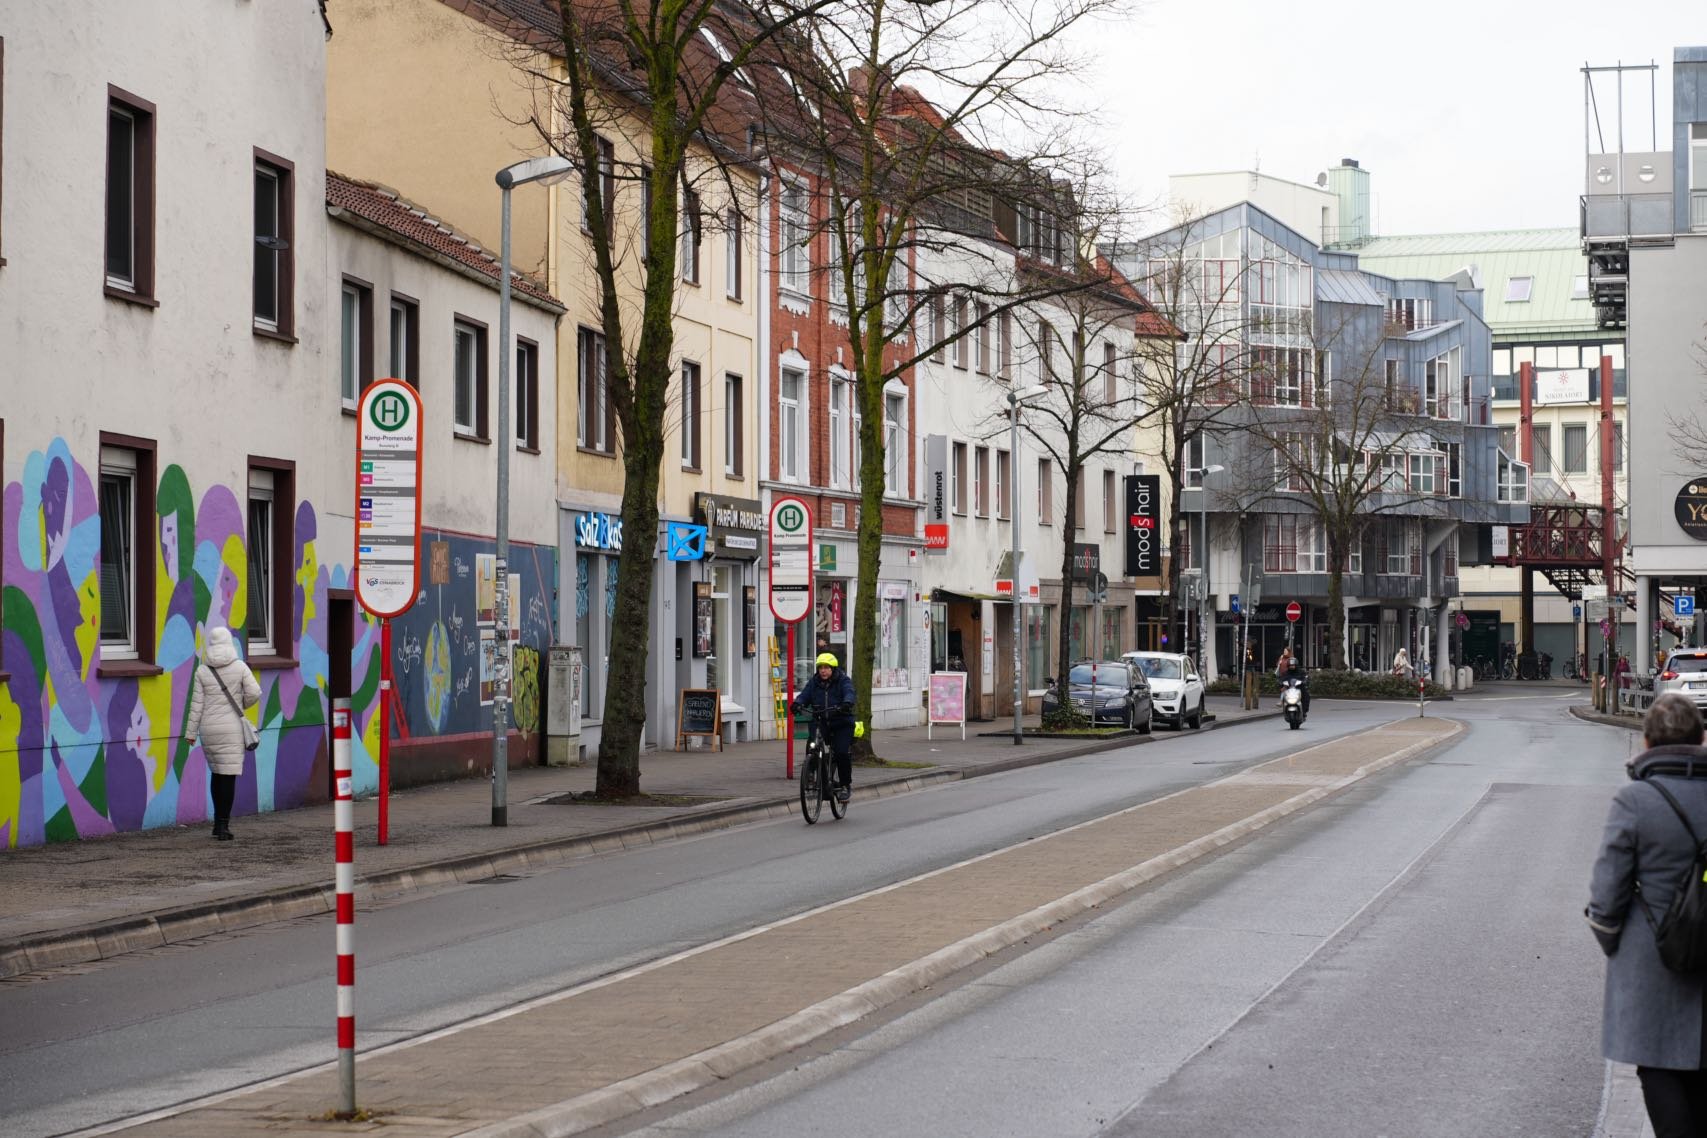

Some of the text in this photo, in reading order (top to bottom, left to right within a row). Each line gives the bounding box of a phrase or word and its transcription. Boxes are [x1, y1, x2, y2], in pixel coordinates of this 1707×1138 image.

[382, 400, 397, 422] H
[934, 471, 943, 520] wüstenrot
[784, 510, 796, 526] H
[832, 582, 840, 631] NAILS
[1678, 598, 1689, 613] P
